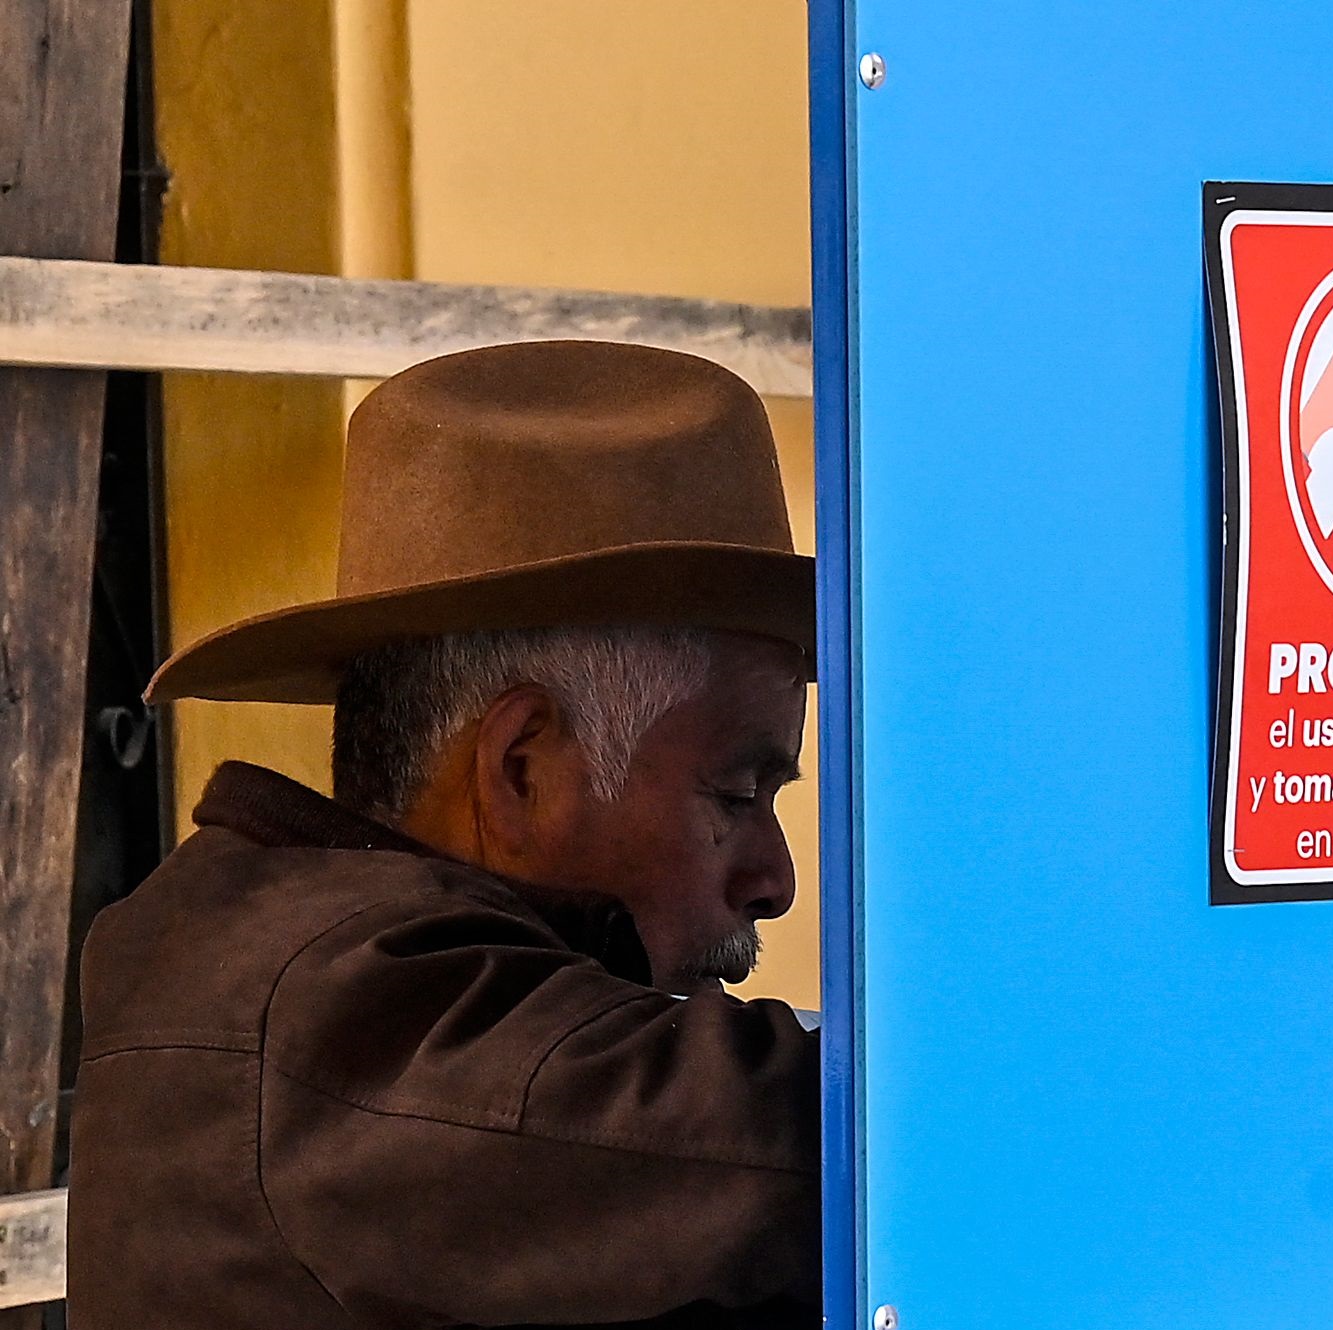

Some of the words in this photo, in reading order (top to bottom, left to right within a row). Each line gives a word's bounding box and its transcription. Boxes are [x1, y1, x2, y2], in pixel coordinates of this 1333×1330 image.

[1268, 708, 1295, 748] el
[1248, 776, 1267, 813] y
[1296, 830, 1332, 860] en
